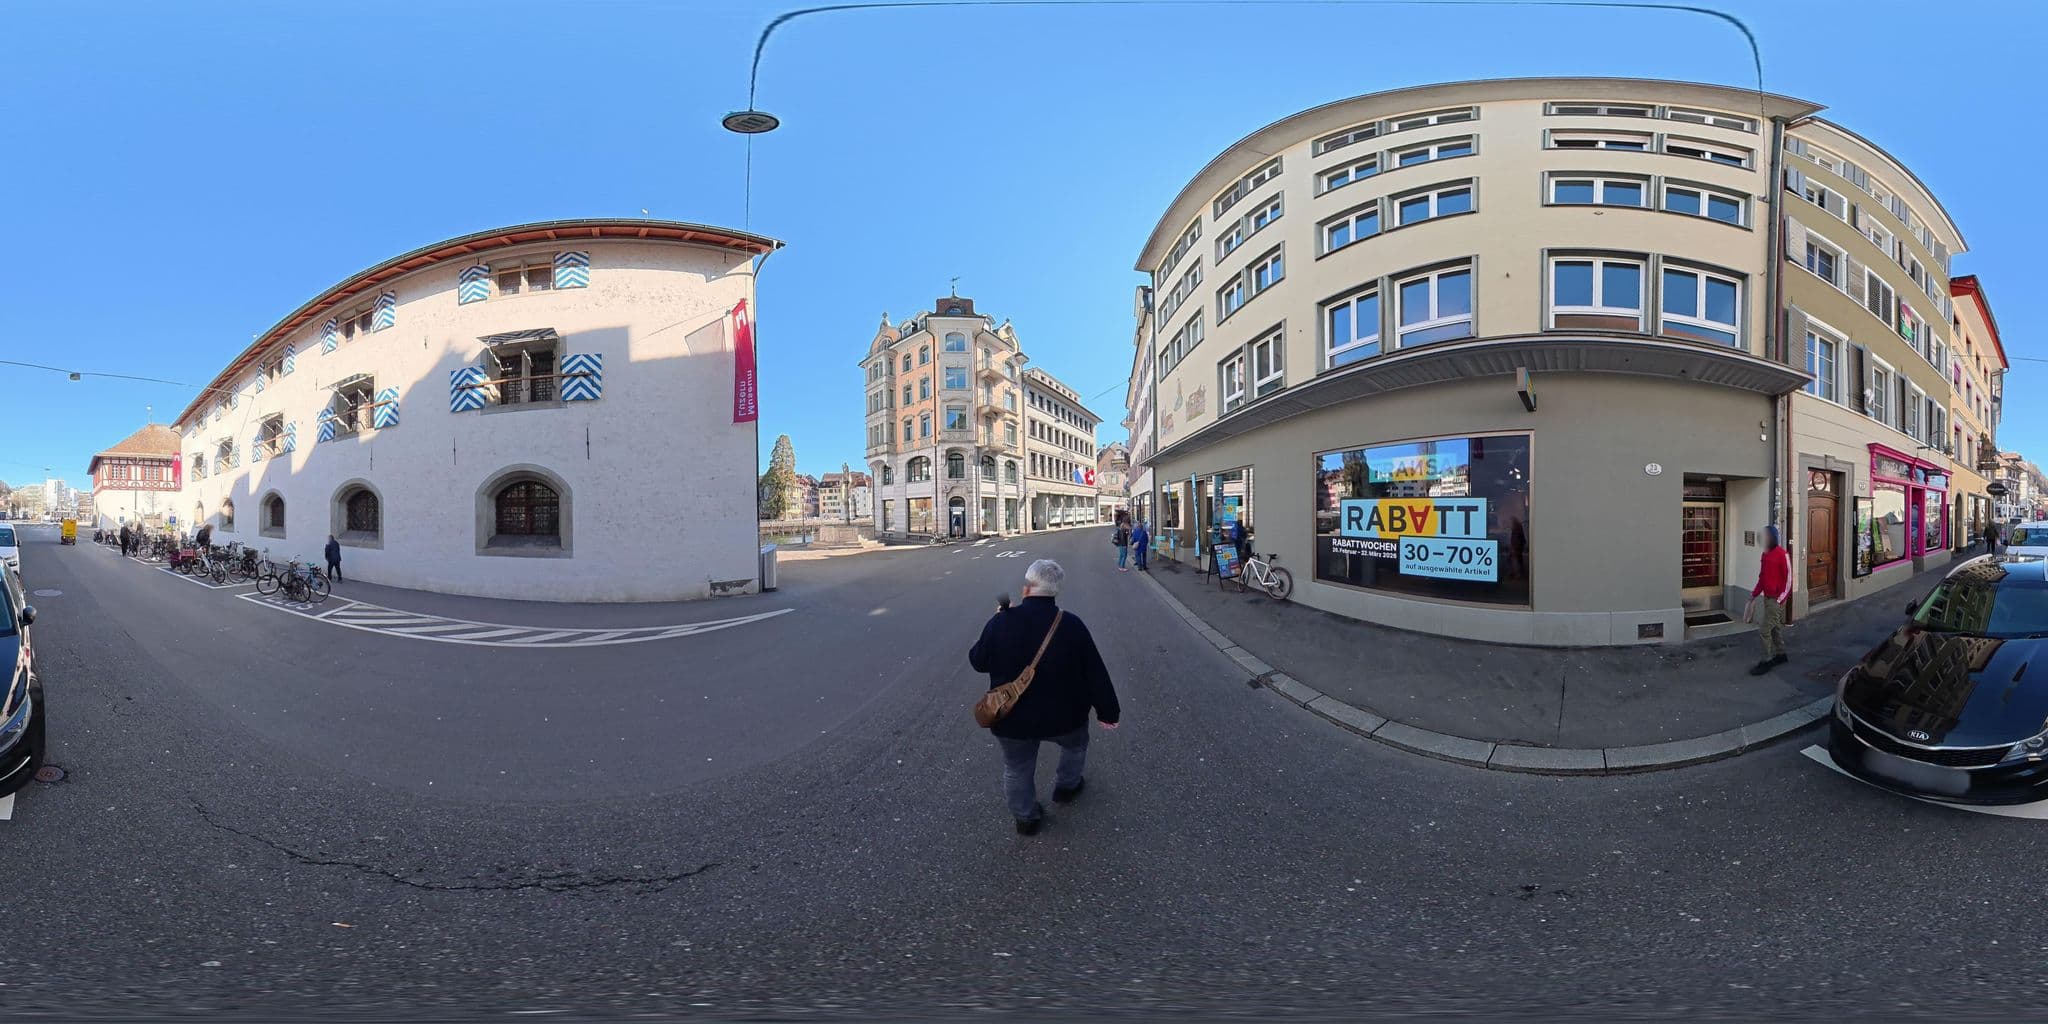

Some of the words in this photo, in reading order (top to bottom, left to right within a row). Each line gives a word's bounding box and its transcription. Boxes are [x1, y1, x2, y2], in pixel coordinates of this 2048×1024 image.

[1347, 505, 1479, 535] RABATT
[1332, 538, 1397, 551] RABATTWOCHEN
[1417, 564, 1463, 574] ausgewählte
[1464, 567, 1490, 576] Artikel
[1910, 730, 1926, 740] KIA
